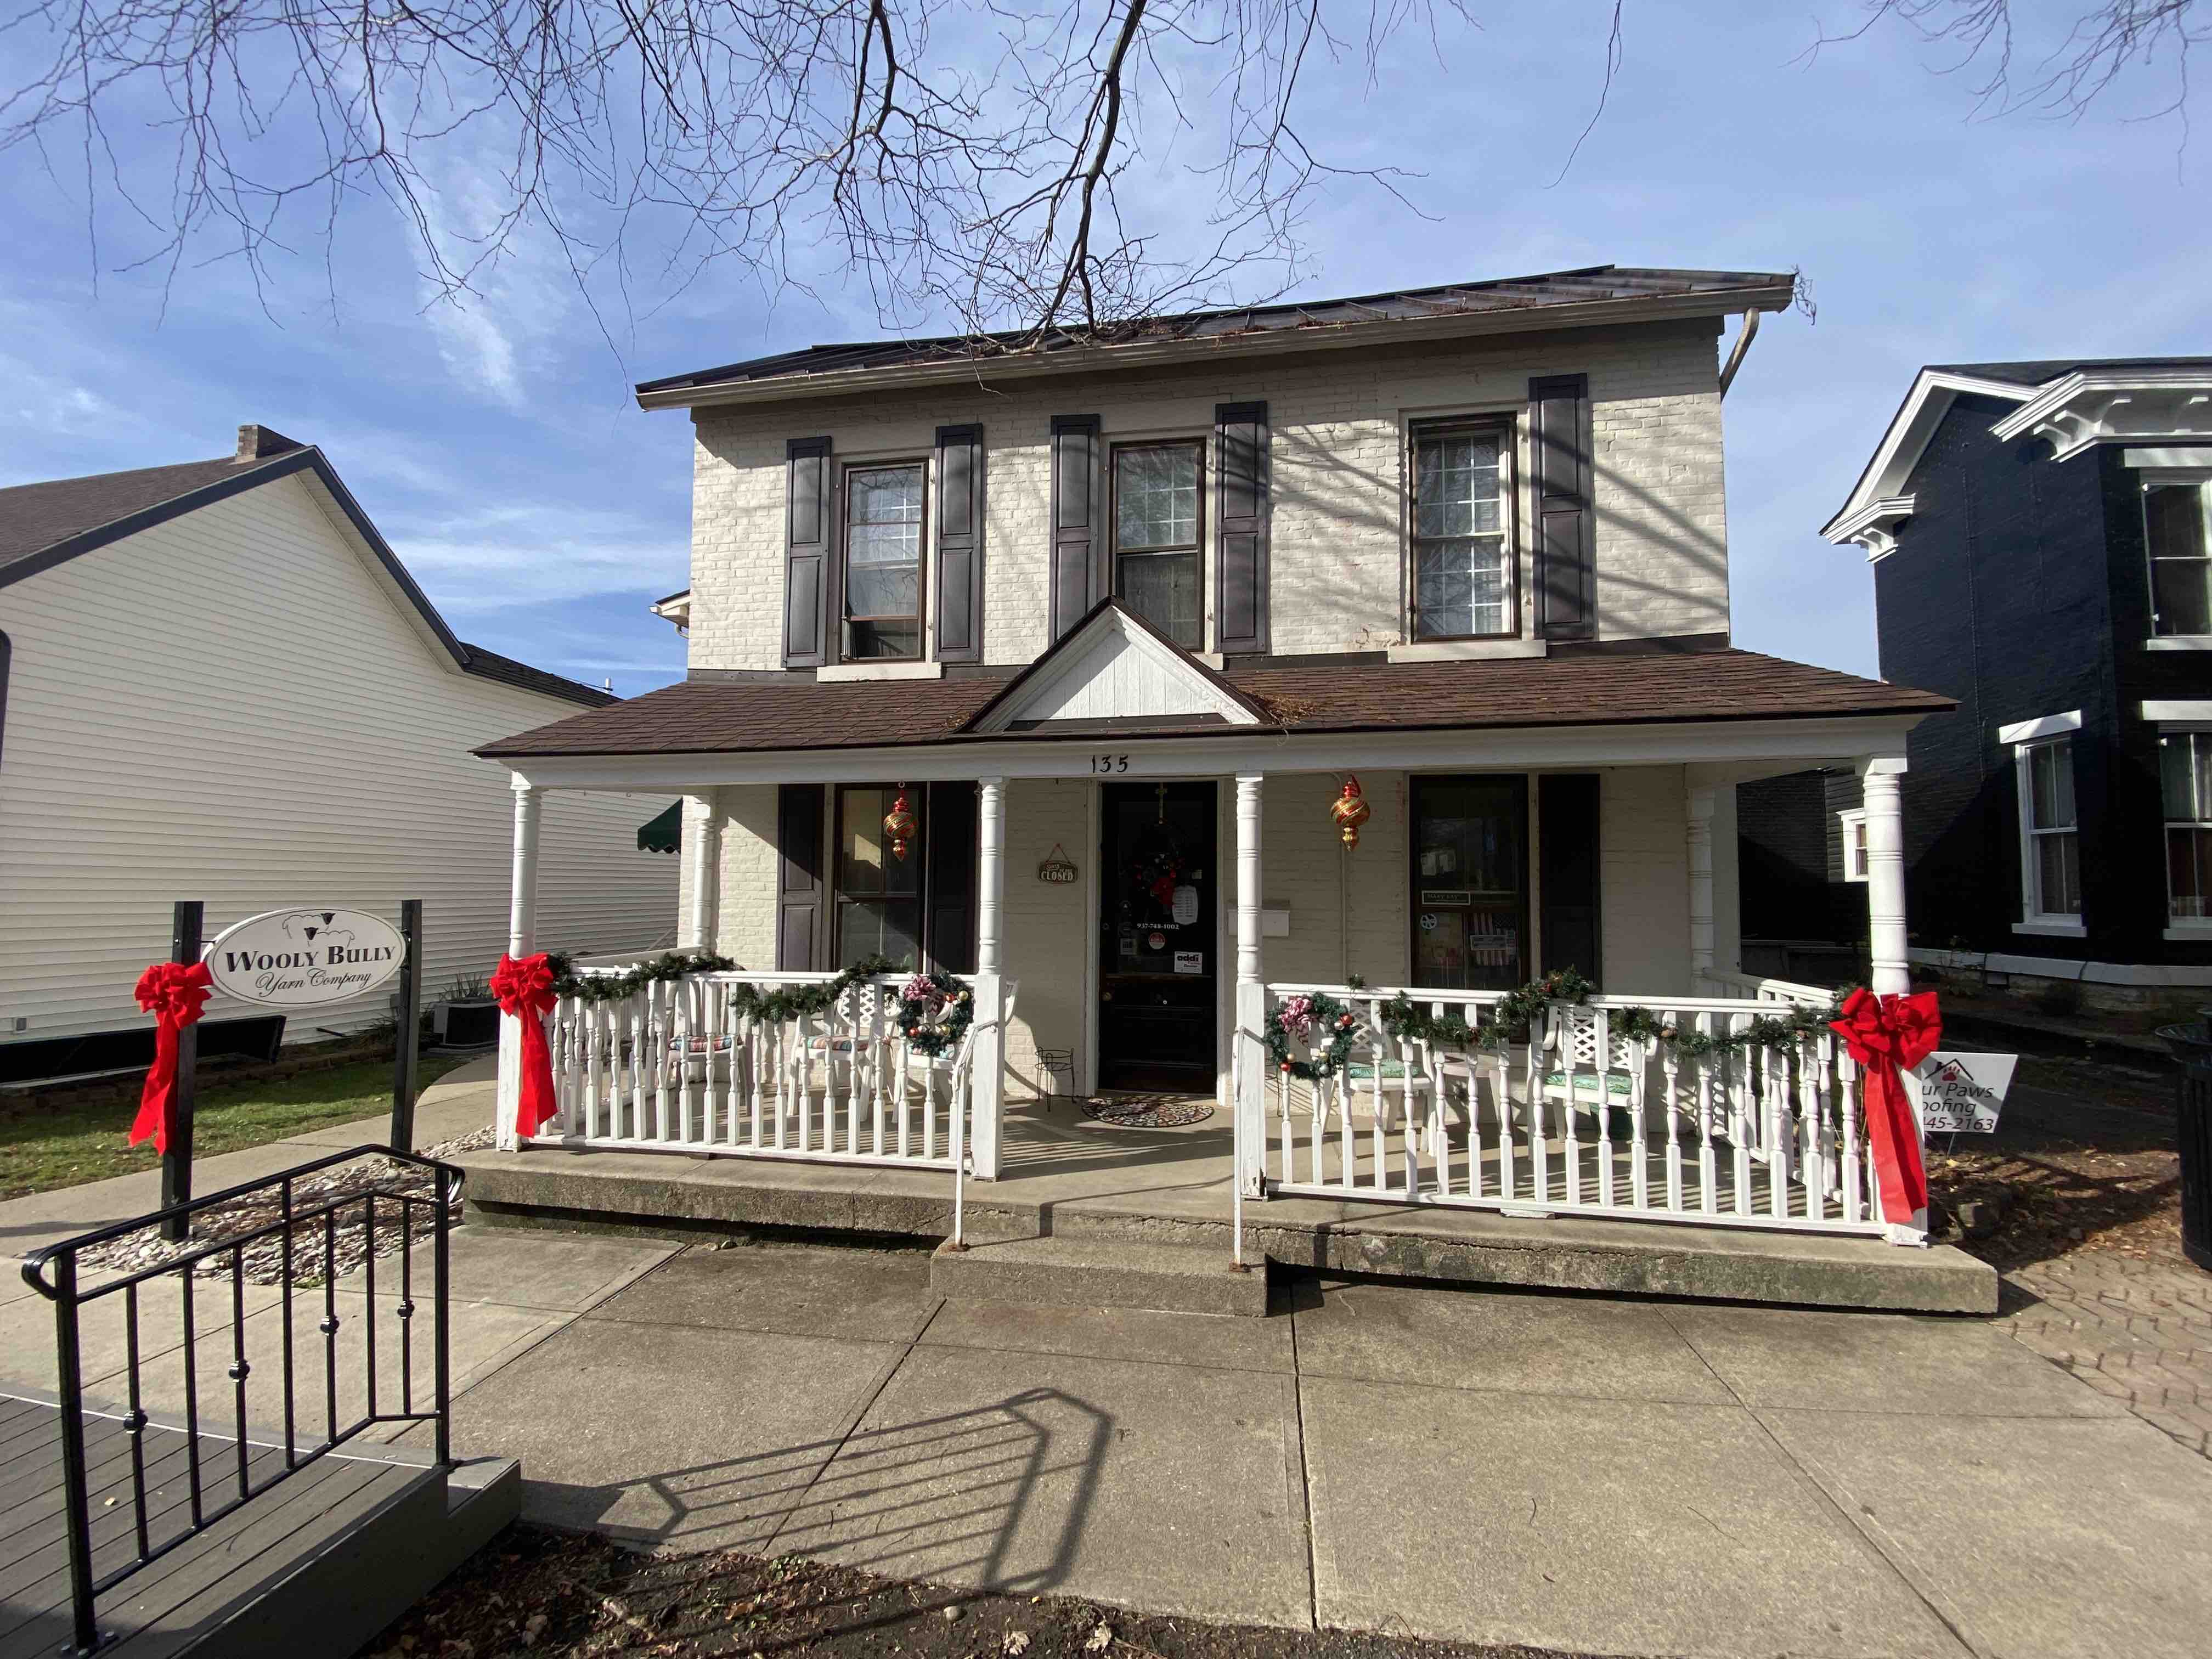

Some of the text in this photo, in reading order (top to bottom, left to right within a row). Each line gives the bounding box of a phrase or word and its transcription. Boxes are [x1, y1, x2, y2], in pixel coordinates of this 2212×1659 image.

[1092, 755, 1128, 773] 135
[1041, 871, 1073, 881] CLOSED
[224, 946, 396, 972] WOOLY BULLY
[255, 968, 373, 997] Yarn Company
[1922, 1082, 1994, 1098] ur Paws
[1923, 1099, 1977, 1116] oofing
